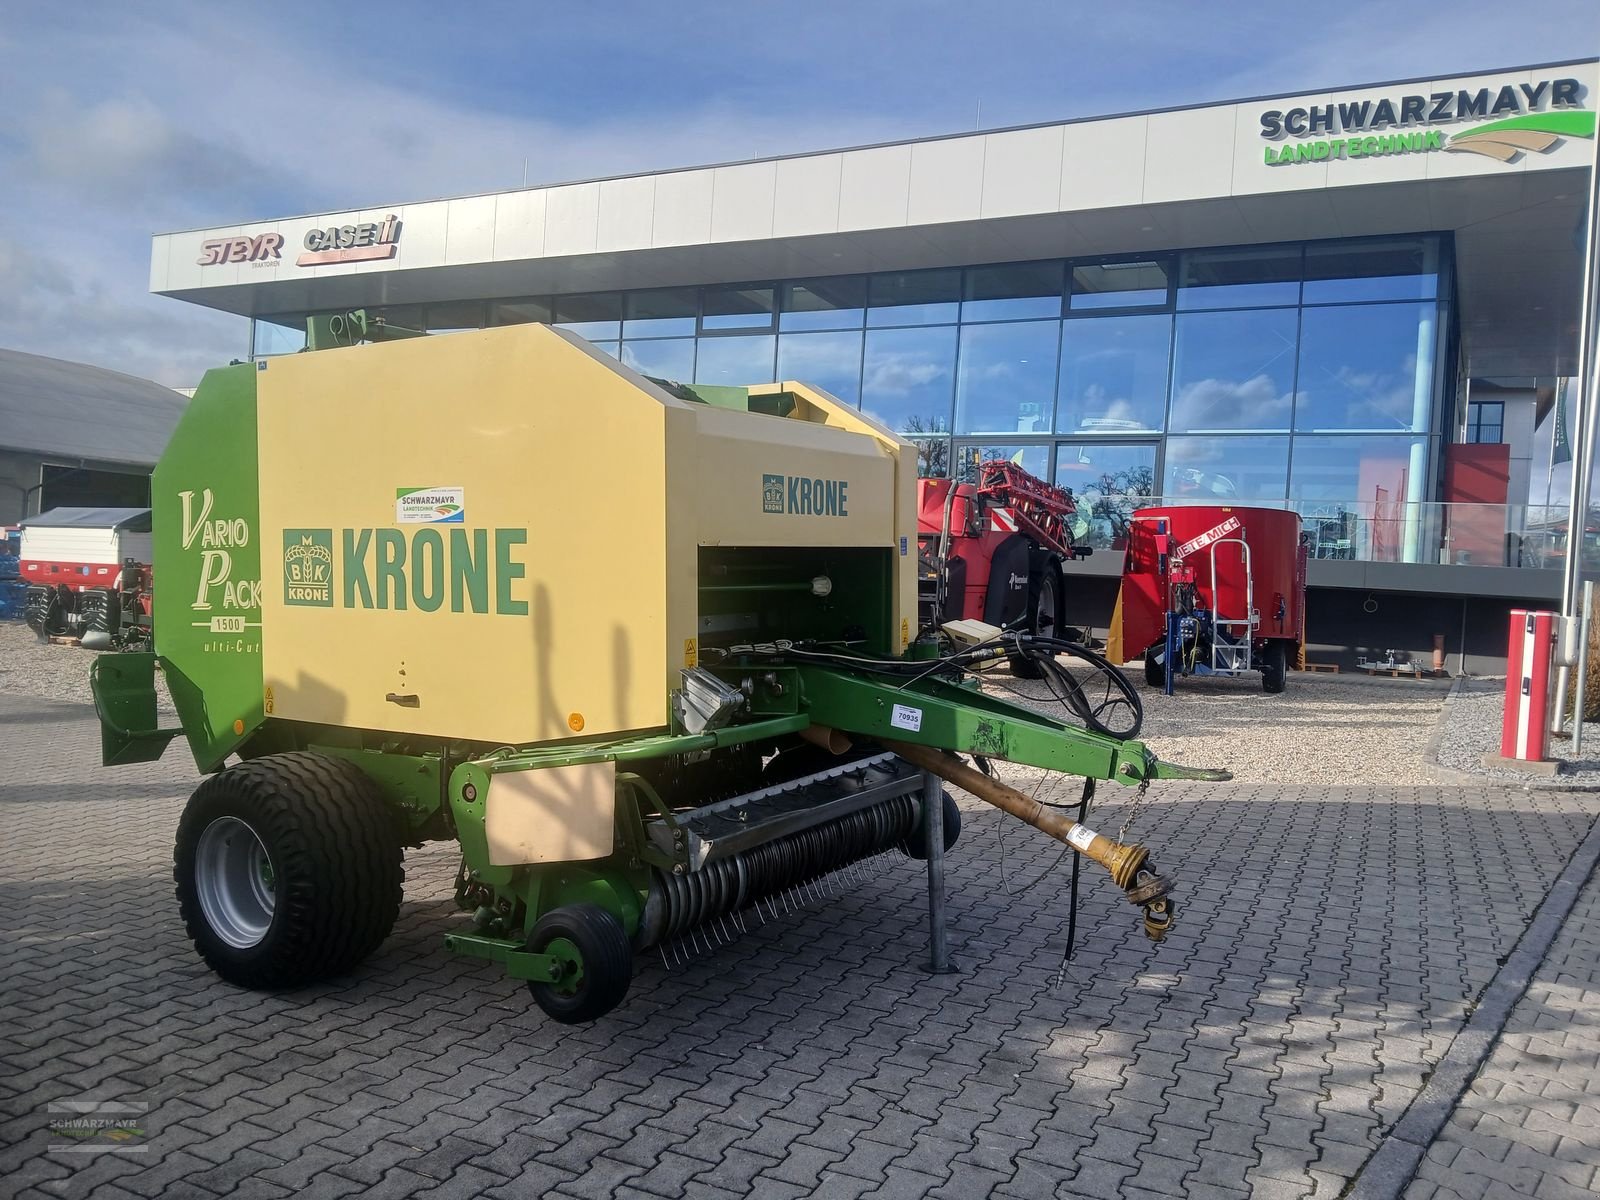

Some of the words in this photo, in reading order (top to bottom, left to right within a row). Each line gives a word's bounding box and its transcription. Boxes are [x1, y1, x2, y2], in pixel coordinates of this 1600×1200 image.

[1260, 78, 1581, 139] SCHWARZMAYR
[1264, 130, 1443, 164] LANDTECHNIK
[197, 233, 282, 265] STEYR
[303, 223, 376, 252] CASE
[402, 496, 455, 504] SCHWARZMAYR
[788, 476, 848, 517] KRONE
[178, 488, 249, 550] VARIO
[1205, 517, 1240, 542] MICH
[302, 535, 312, 546] M
[191, 550, 262, 610] PACK
[342, 528, 529, 616] KRONE
[288, 588, 329, 601] KRONE
[216, 618, 240, 631] 1500
[898, 713, 919, 722] 70935
